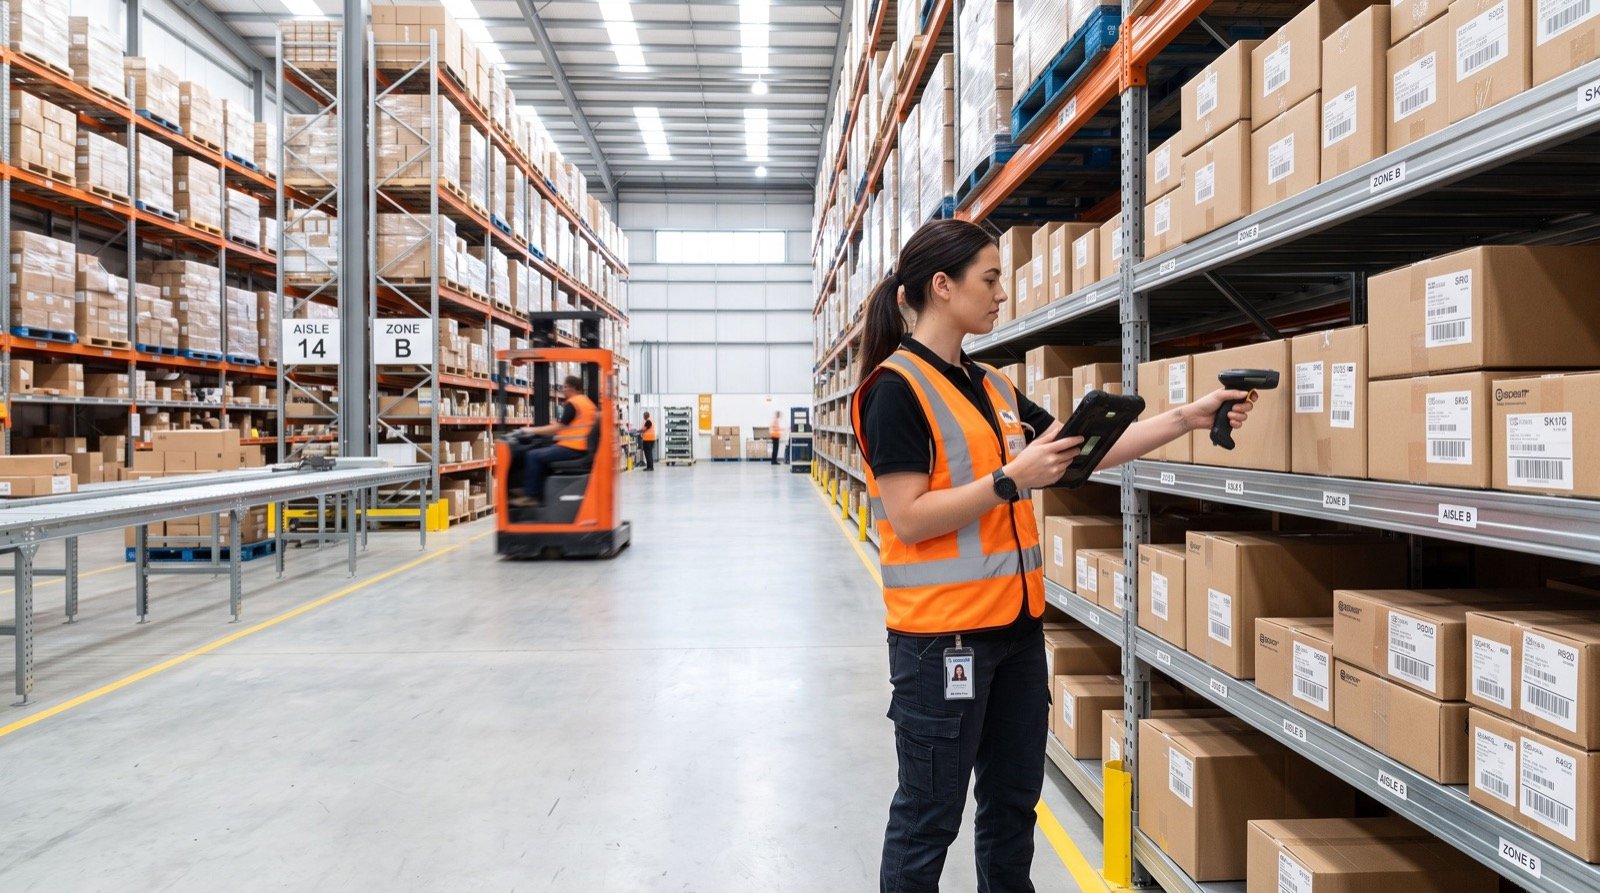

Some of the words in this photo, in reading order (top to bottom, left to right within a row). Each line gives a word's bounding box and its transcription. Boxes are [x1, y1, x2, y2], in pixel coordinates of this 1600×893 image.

[1373, 171, 1393, 187] ZONE
[1395, 167, 1401, 178] B
[293, 324, 329, 334] AISLE
[386, 324, 420, 334] ZONE
[298, 338, 326, 359] 14
[395, 338, 412, 358] B
[1325, 495, 1341, 505] ZONE
[1341, 496, 1346, 506] B
[1443, 509, 1464, 522] AISLE
[1466, 511, 1471, 522] B
[1285, 721, 1299, 735] AISLE
[1380, 773, 1398, 792] AISLE
[1503, 843, 1528, 867] ZONE
